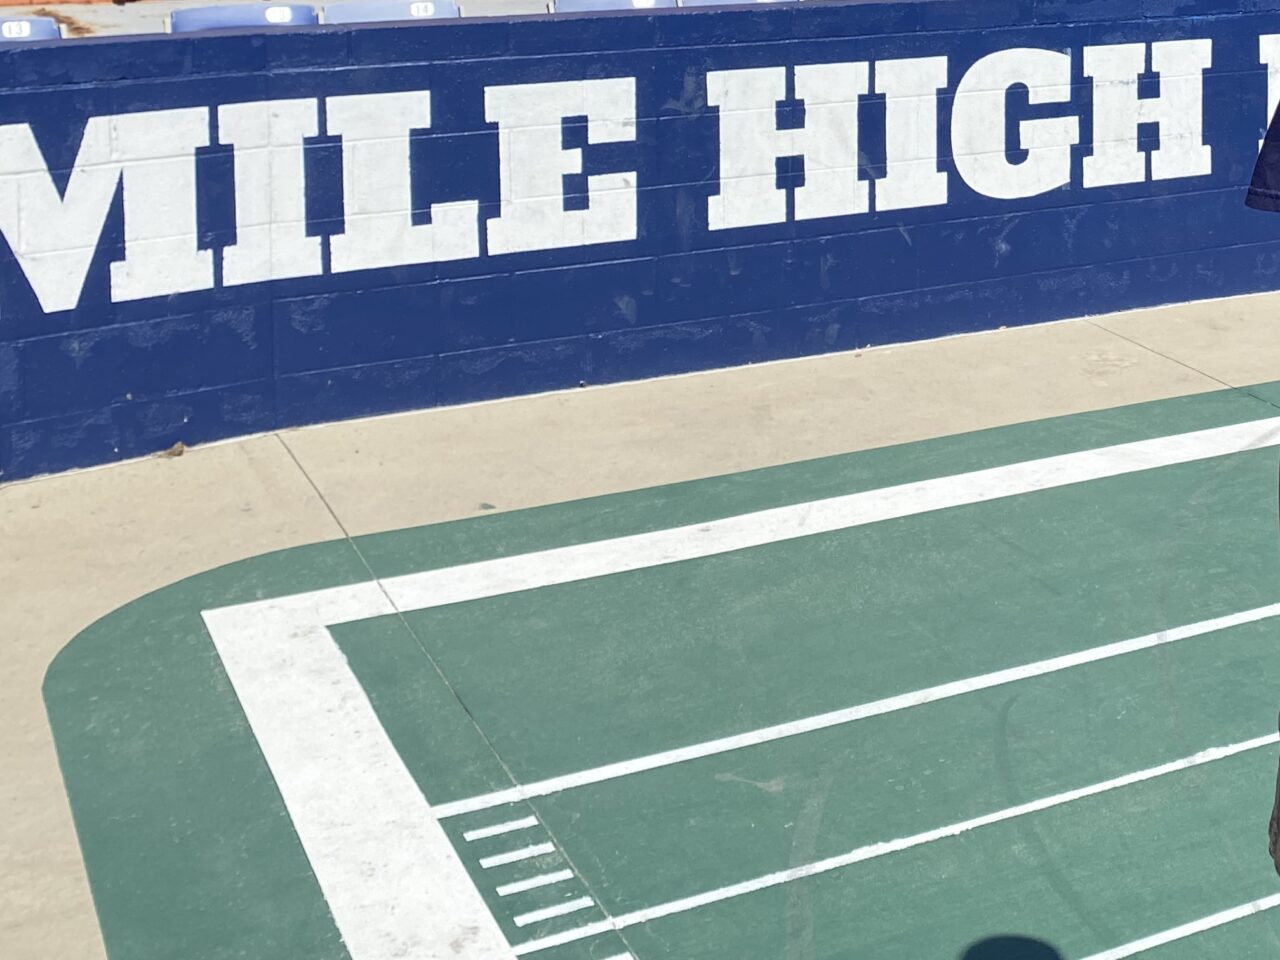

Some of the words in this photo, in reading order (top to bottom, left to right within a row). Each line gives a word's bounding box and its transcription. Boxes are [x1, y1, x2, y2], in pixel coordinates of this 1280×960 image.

[416, 3, 429, 15] 14
[7, 22, 24, 36] 13
[0, 77, 637, 314] MILE
[706, 38, 1212, 230] HIGH
